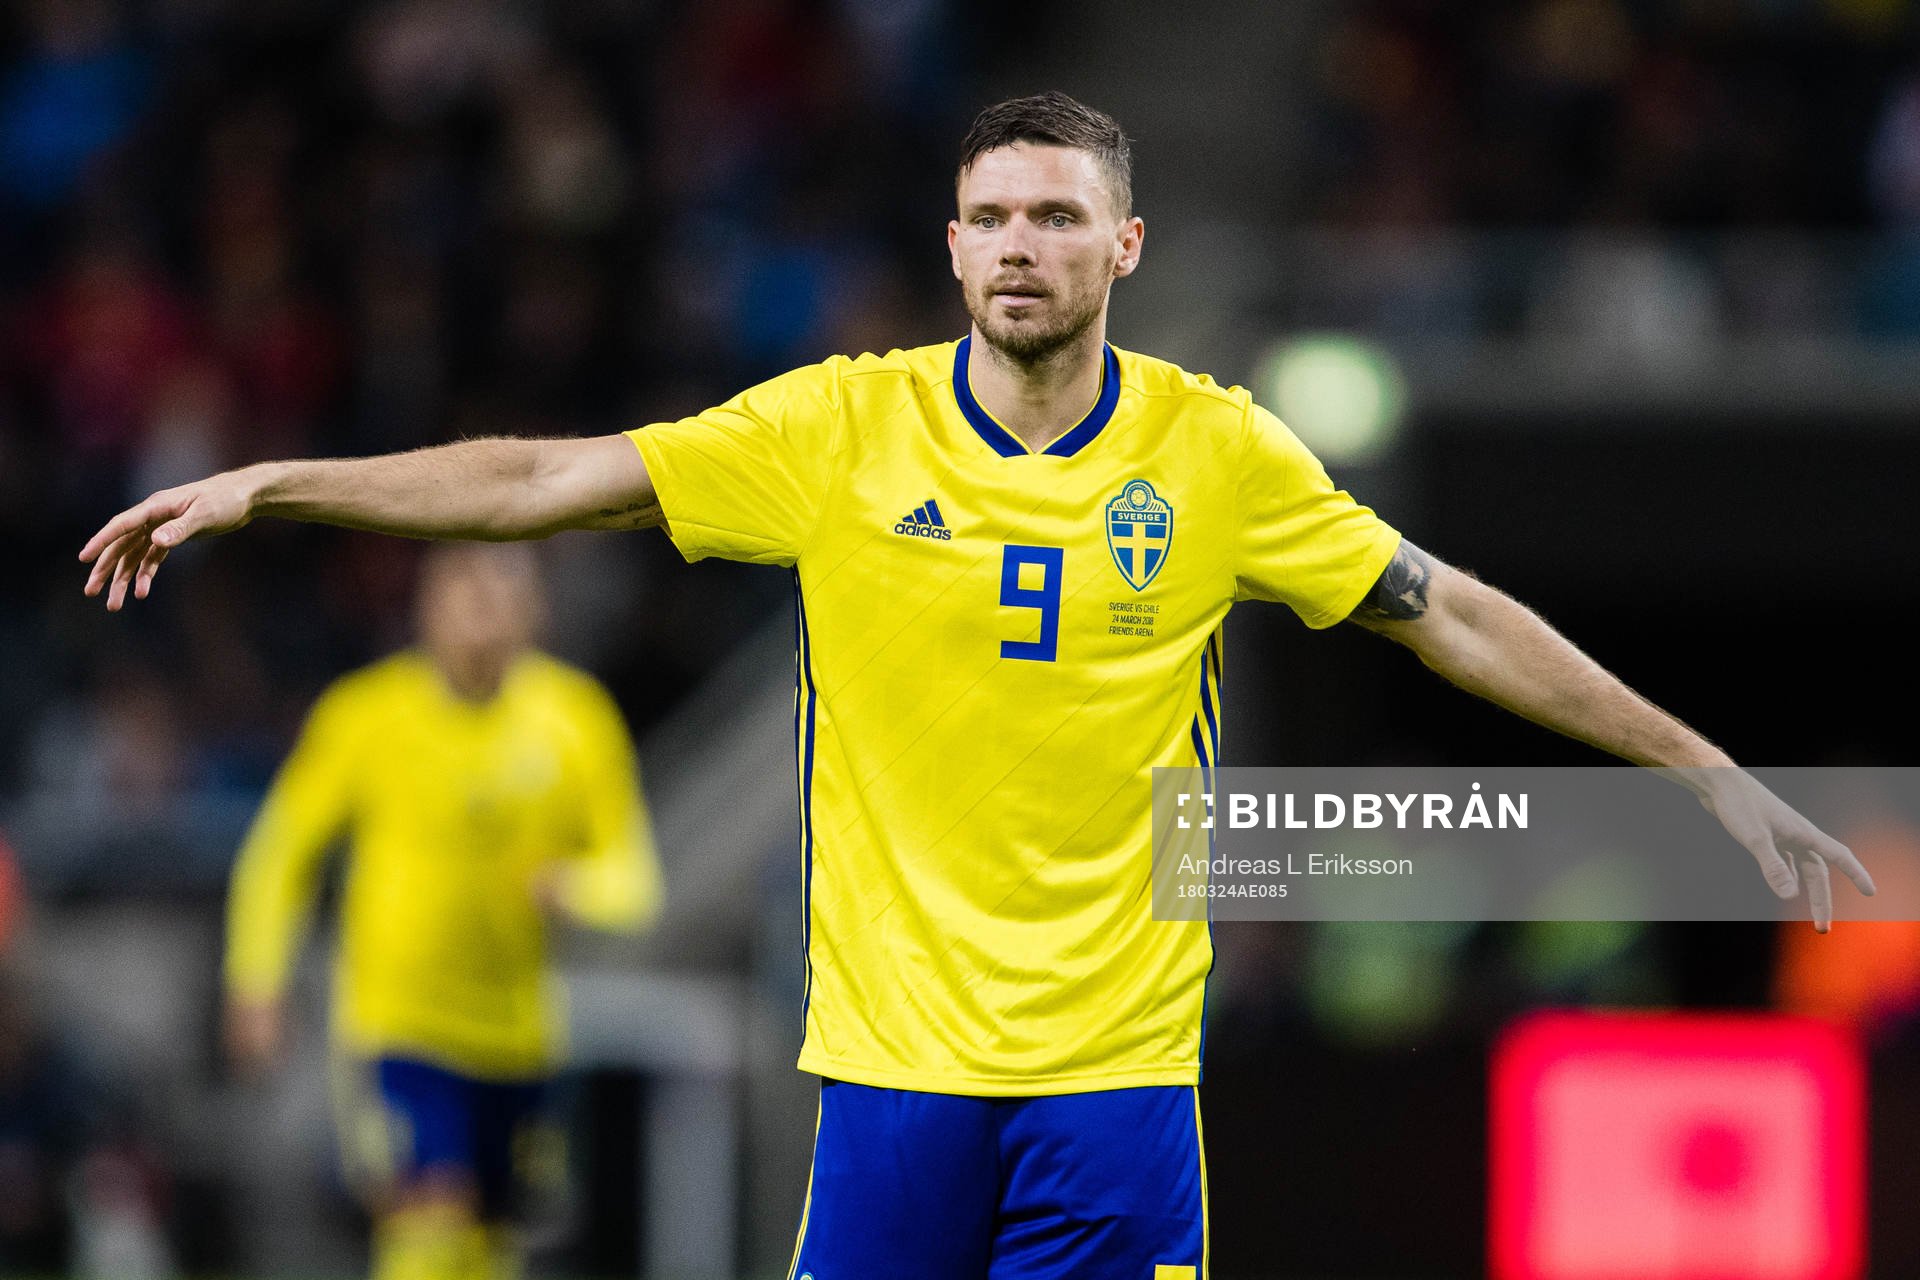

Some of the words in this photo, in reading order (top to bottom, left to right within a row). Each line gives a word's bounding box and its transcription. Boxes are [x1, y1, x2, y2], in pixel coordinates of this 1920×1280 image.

[1117, 512, 1161, 522] SVERIGE
[894, 522, 952, 541] adidas
[999, 544, 1064, 663] 9
[1109, 601, 1133, 613] SVERIGE
[1134, 603, 1143, 613] VS
[1143, 604, 1160, 614] CHILE
[1112, 614, 1119, 624] 24
[1119, 614, 1142, 625] MARCH
[1109, 625, 1134, 636] FRIENDS
[1135, 627, 1154, 637] ARENA
